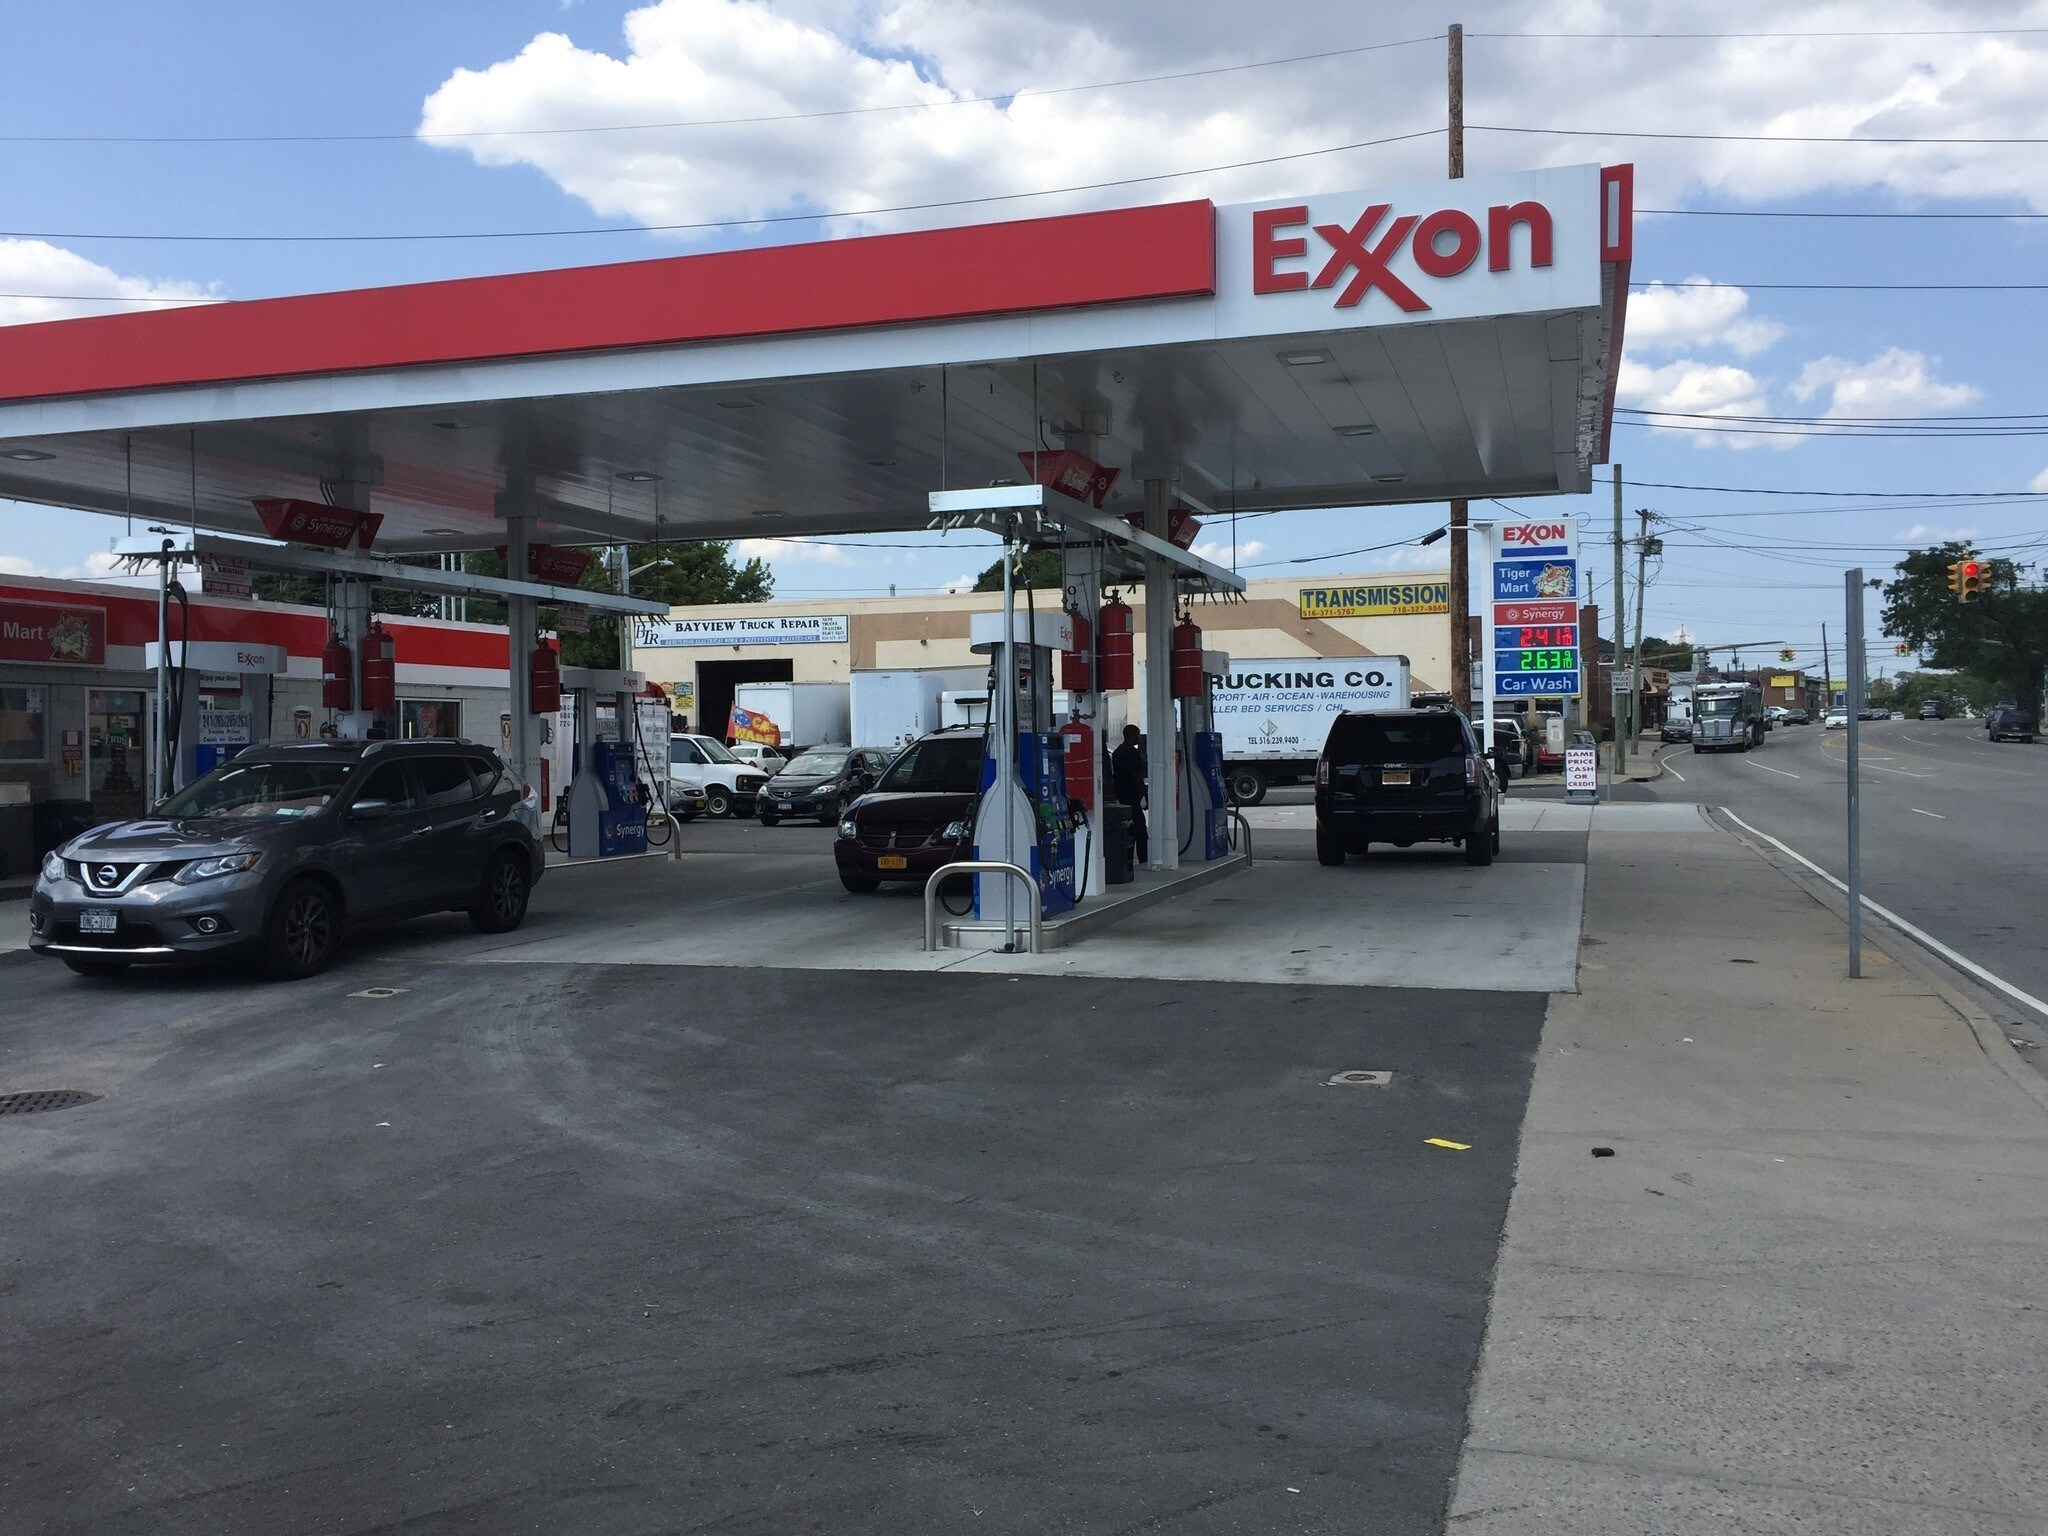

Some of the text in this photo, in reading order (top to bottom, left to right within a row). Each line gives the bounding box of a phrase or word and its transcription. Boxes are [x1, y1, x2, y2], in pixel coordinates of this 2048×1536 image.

[1253, 201, 1553, 311] Exxon
[1098, 477, 1107, 490] 8
[307, 518, 350, 538] Synergy
[1136, 518, 1144, 529] 5
[1170, 514, 1179, 527] 6
[1503, 524, 1566, 545] EXXON
[1499, 568, 1531, 580] Tiger
[1500, 582, 1530, 593] Mart
[1302, 585, 1447, 609] TRANSMISSION
[1522, 609, 1565, 621] Synergy
[3, 621, 44, 640] Mart
[675, 618, 820, 632] BAYVIEW TRUCK REPAIR
[237, 652, 265, 667] Exxon
[1520, 650, 1561, 670] 2.63
[1210, 671, 1393, 690] RUCKING CO.
[1502, 676, 1572, 691] Car Wash
[1213, 691, 1391, 702] XPORT AIR OCEAN WAREHOUSING
[1241, 705, 1261, 713] BED
[1264, 703, 1314, 713] SERVICES
[1248, 737, 1258, 745] TEL
[616, 823, 645, 838] Synergy
[1048, 865, 1074, 890] Synergy
